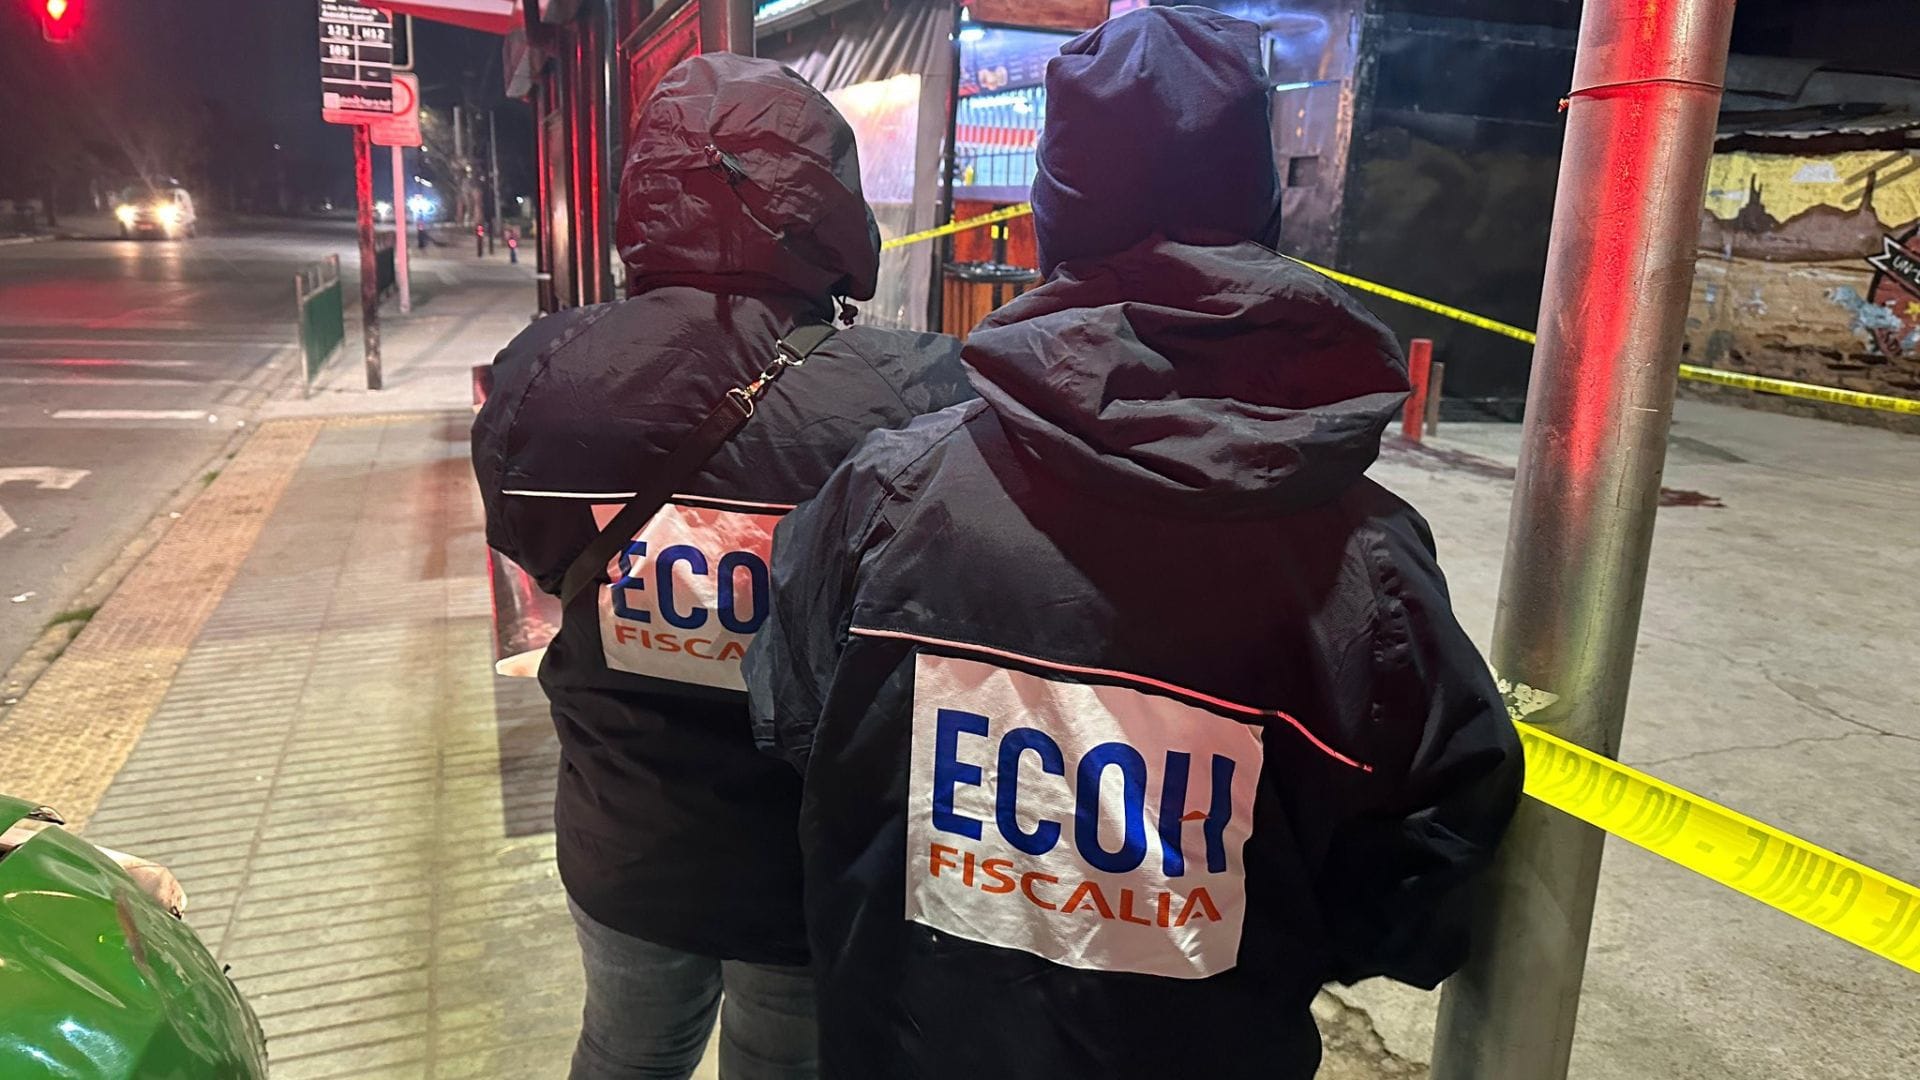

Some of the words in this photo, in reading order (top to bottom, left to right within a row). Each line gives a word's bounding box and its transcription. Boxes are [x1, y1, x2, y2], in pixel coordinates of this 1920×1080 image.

[611, 541, 769, 635] ECO
[931, 707, 1236, 878] ECOH
[929, 842, 1222, 928] FISCALIA
